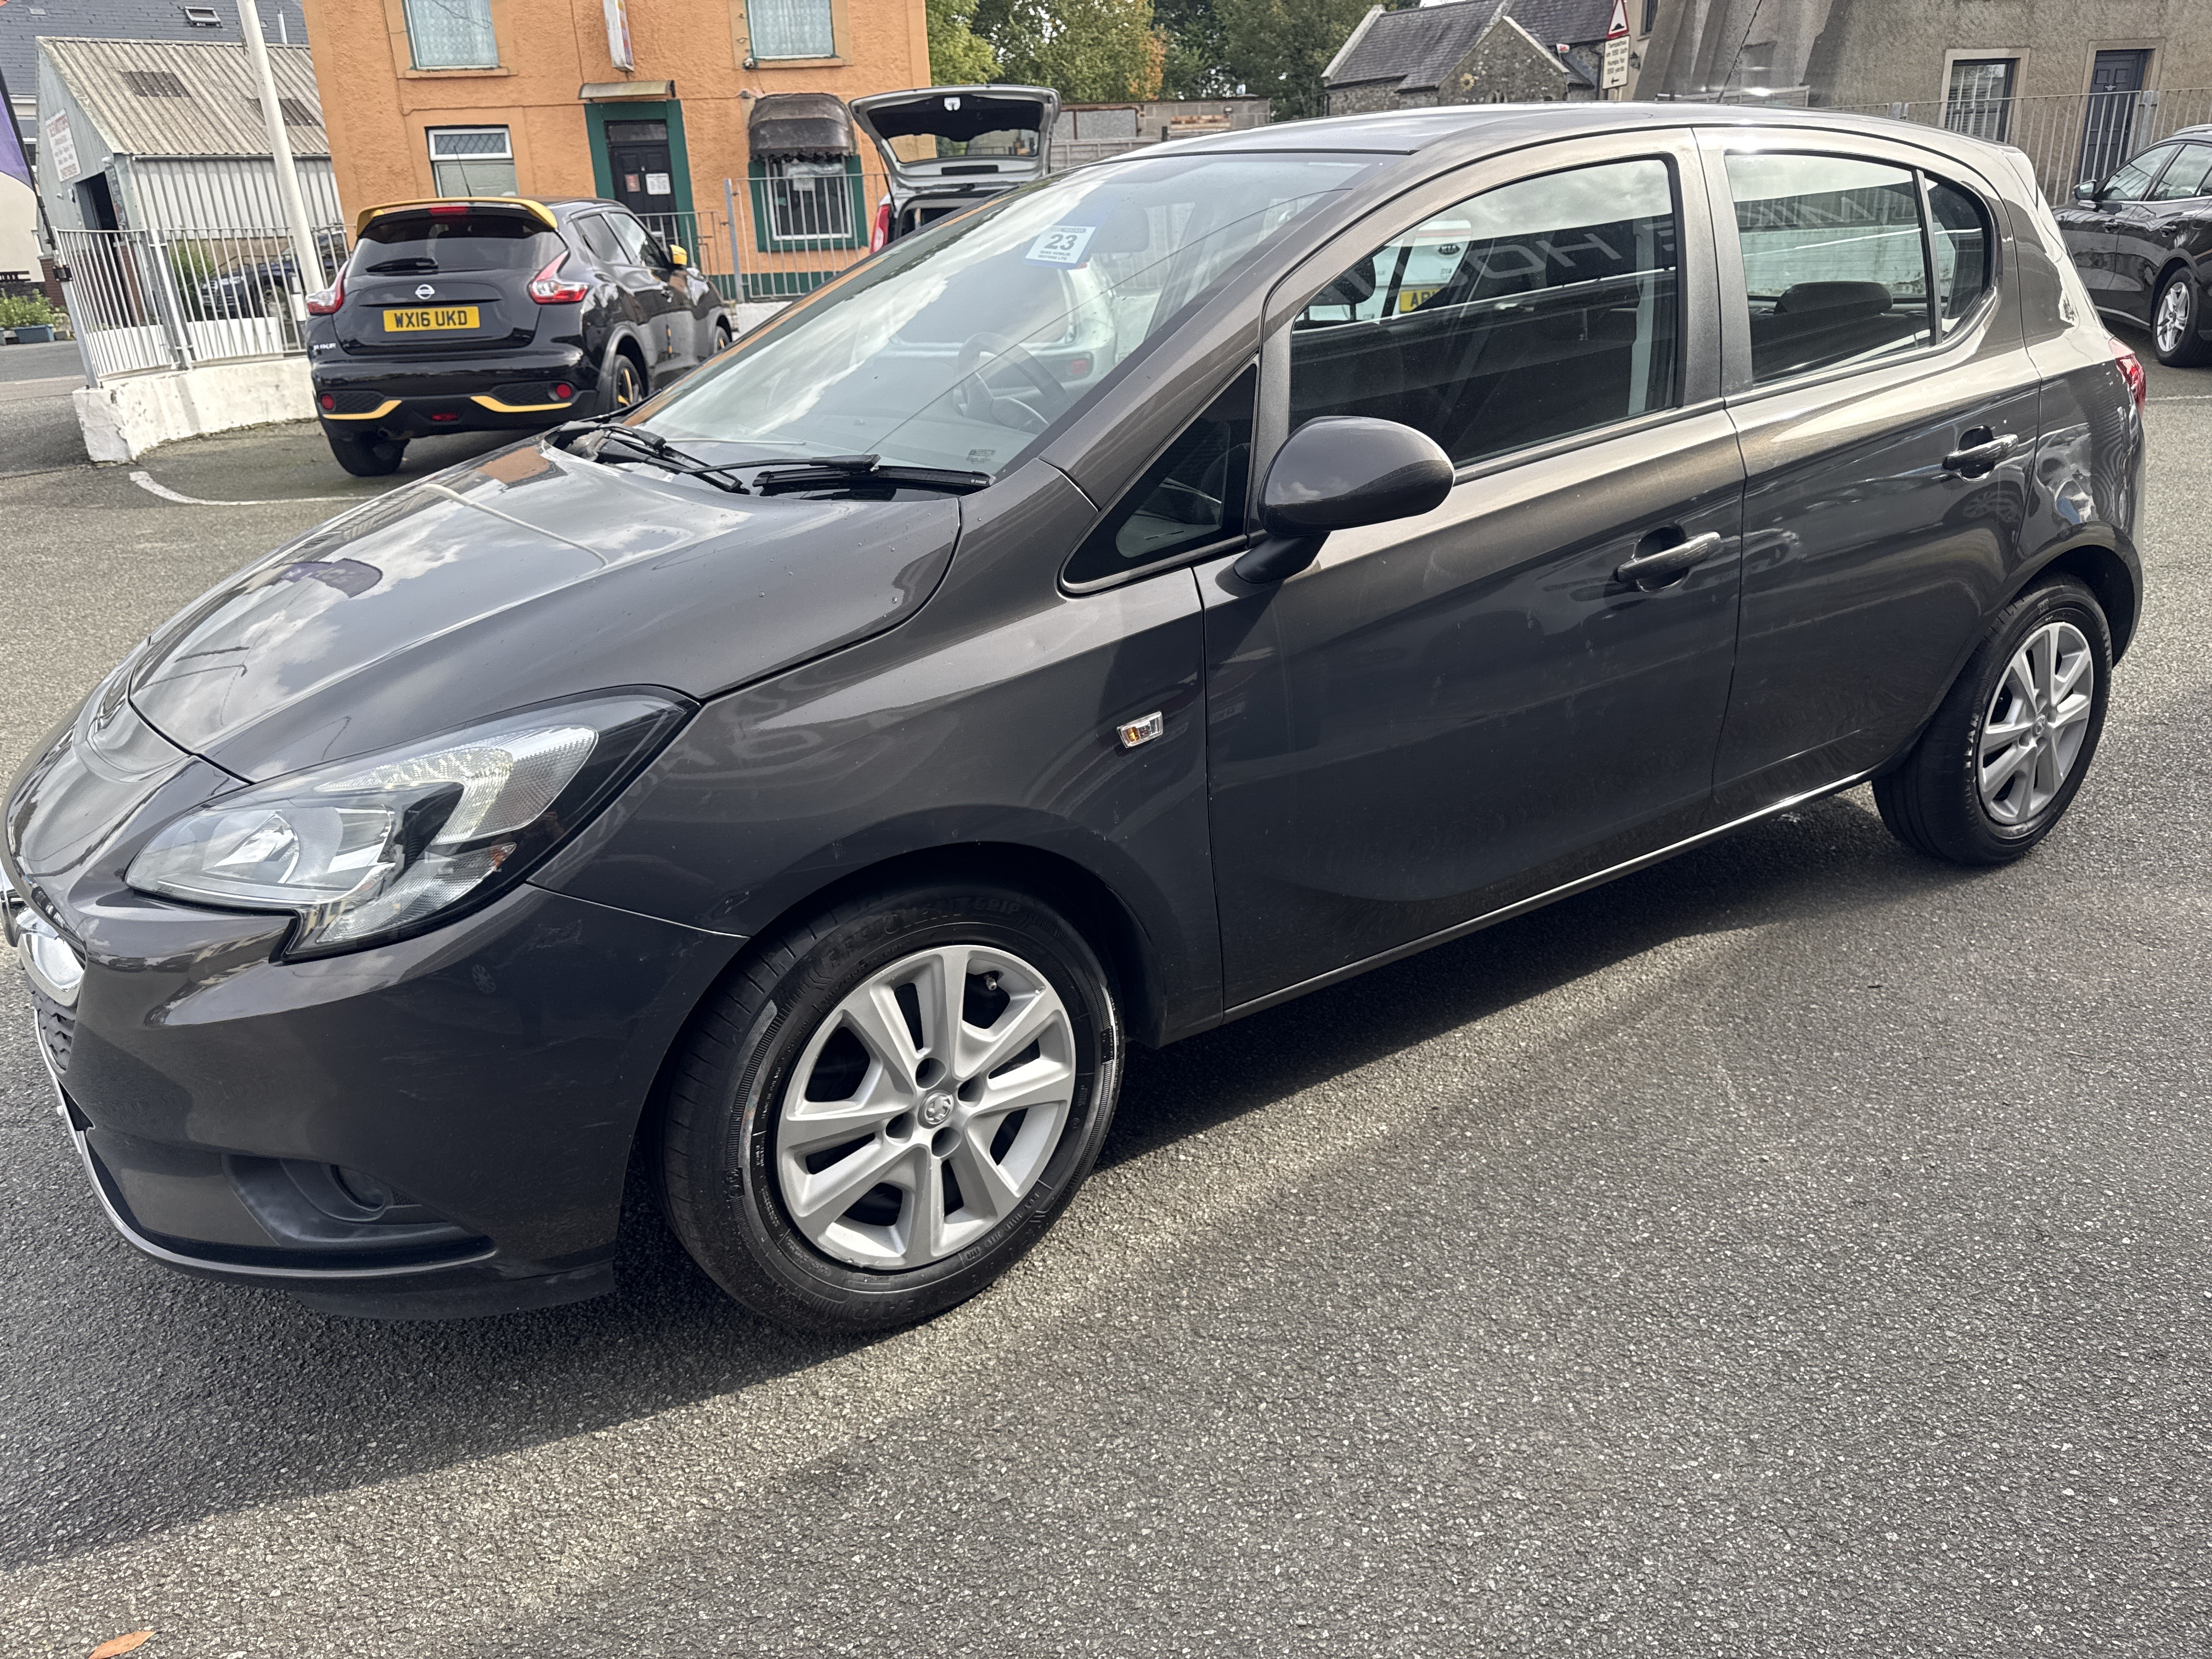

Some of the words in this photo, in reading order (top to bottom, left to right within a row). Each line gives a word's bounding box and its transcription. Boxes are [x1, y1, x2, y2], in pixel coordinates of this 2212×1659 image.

[1044, 234, 1077, 250] 23
[394, 312, 431, 328] WX16
[435, 310, 468, 326] UKD
